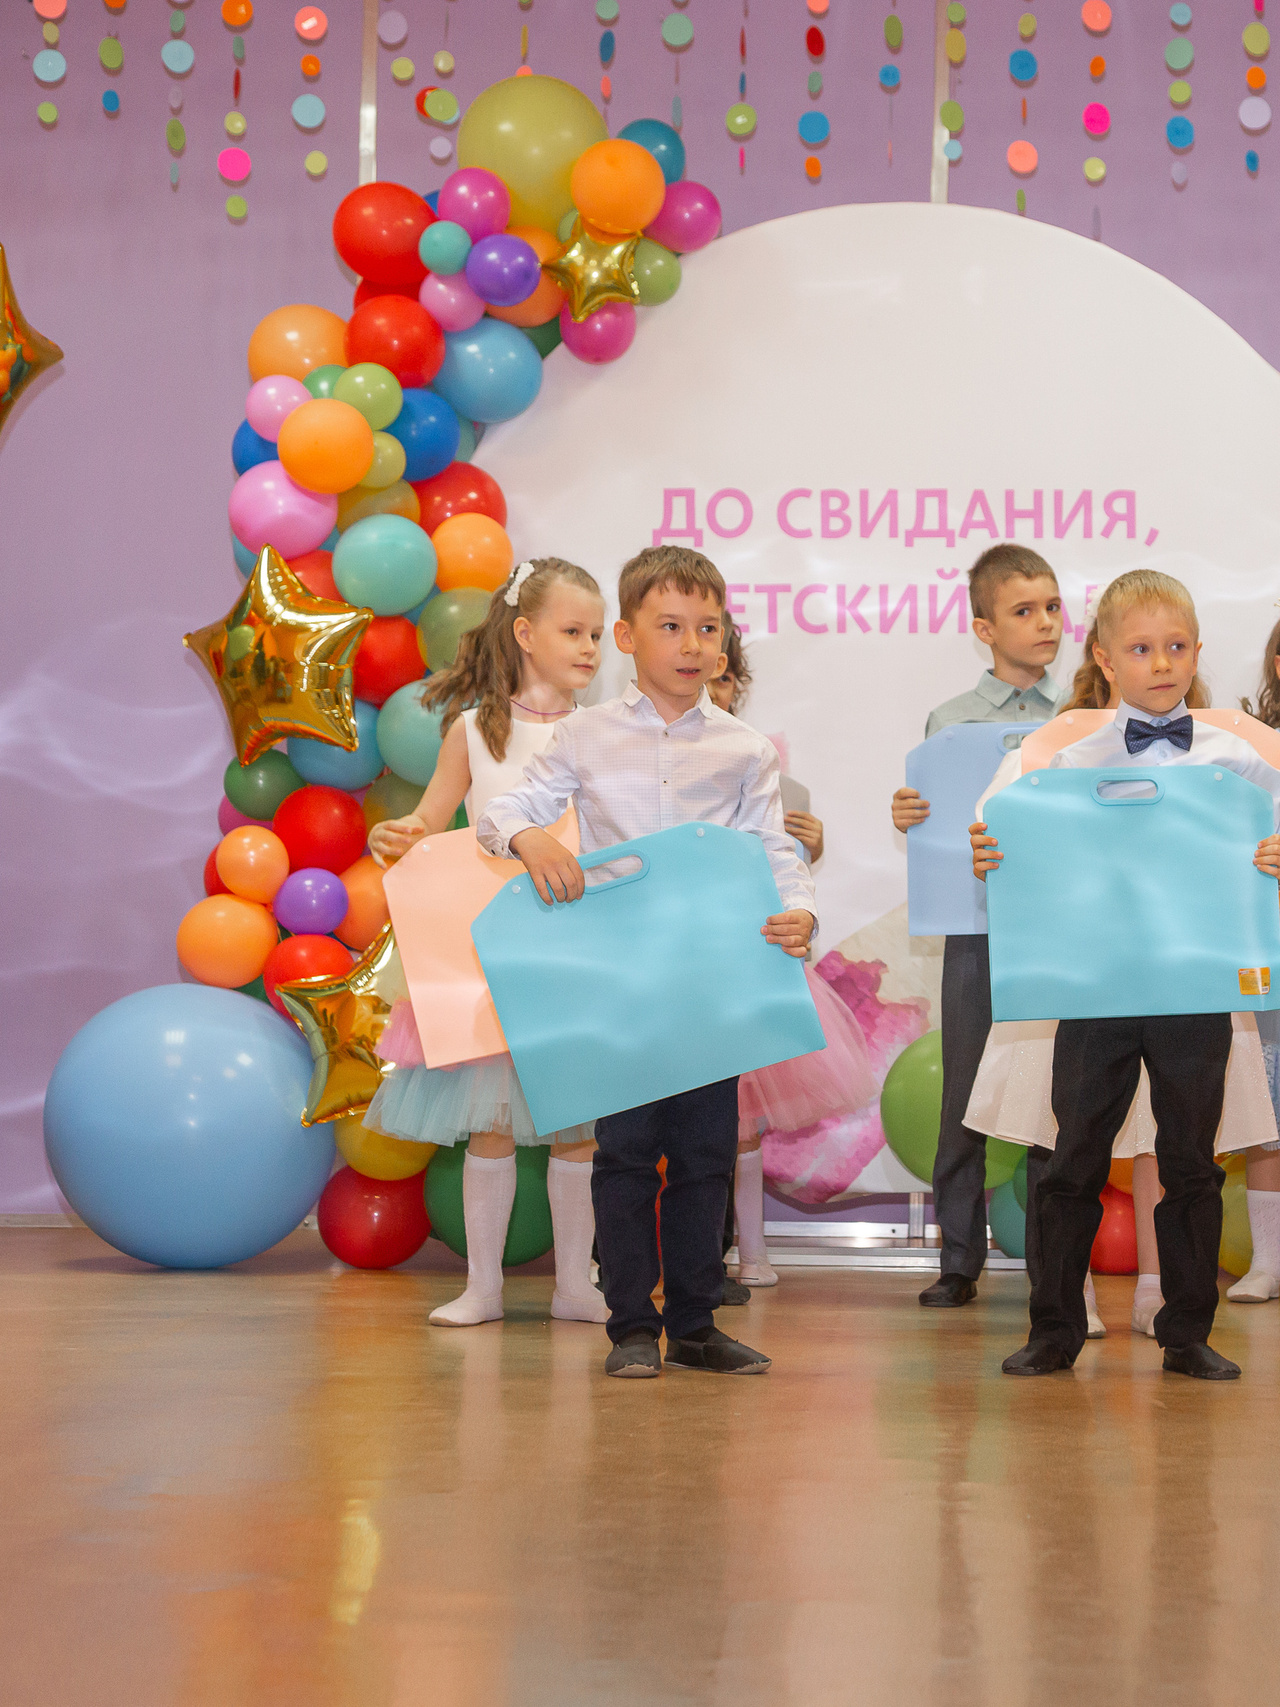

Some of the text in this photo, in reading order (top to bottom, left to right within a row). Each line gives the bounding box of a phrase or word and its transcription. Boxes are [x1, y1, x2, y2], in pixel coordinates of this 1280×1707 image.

[652, 487, 1159, 547] ДО СВИДАНИЯ,
[725, 568, 968, 634] ЕТСКИЙ
